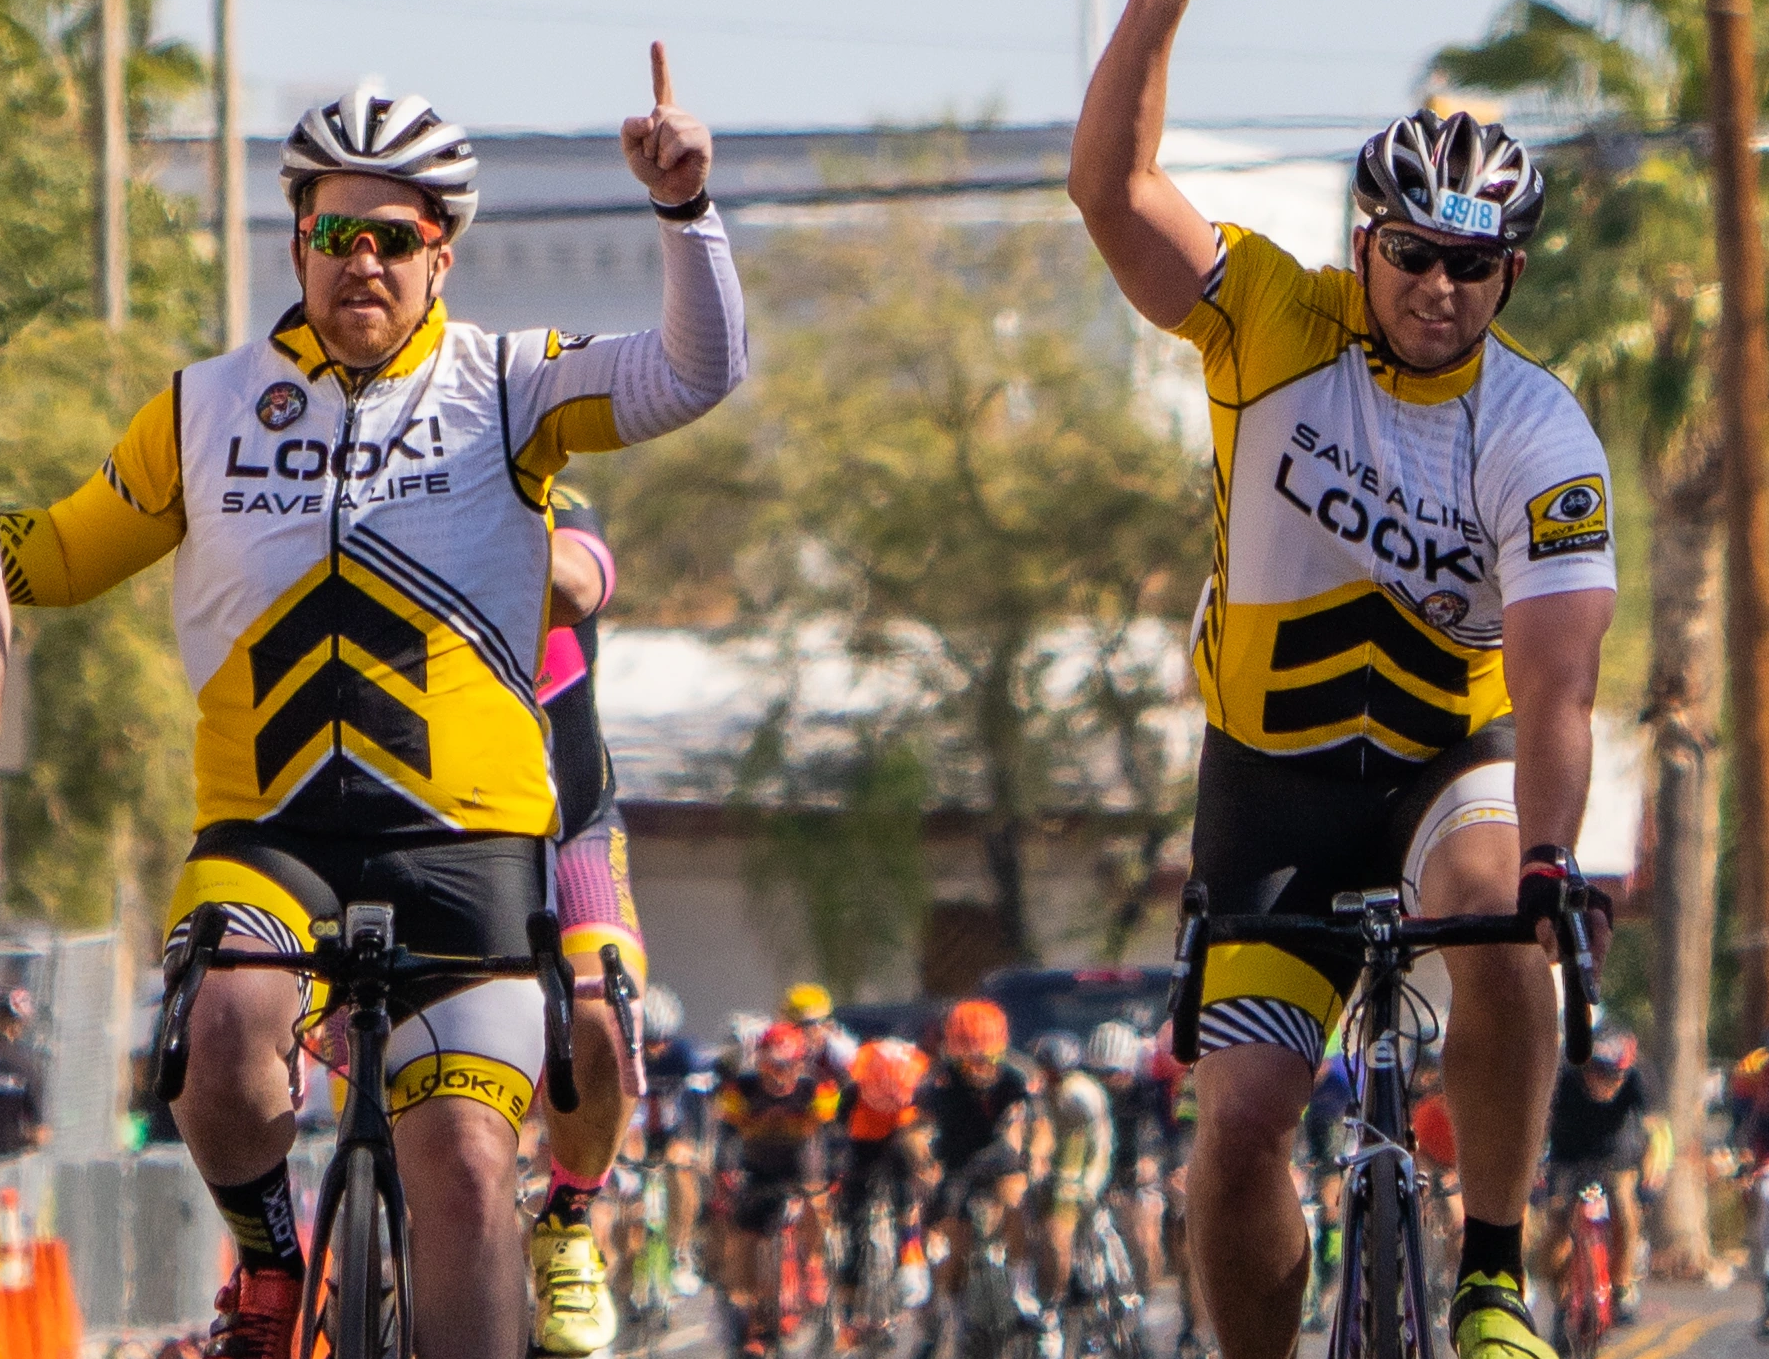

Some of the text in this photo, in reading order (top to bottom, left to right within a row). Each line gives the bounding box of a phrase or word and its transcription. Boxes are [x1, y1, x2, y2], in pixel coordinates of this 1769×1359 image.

[1440, 194, 1494, 230] 8918
[225, 415, 444, 480] LOOK!
[1291, 423, 1379, 496] SAVE
[1386, 486, 1408, 514] A
[221, 472, 451, 515] SAVE A LIFE
[405, 1070, 505, 1102] LOOK!
